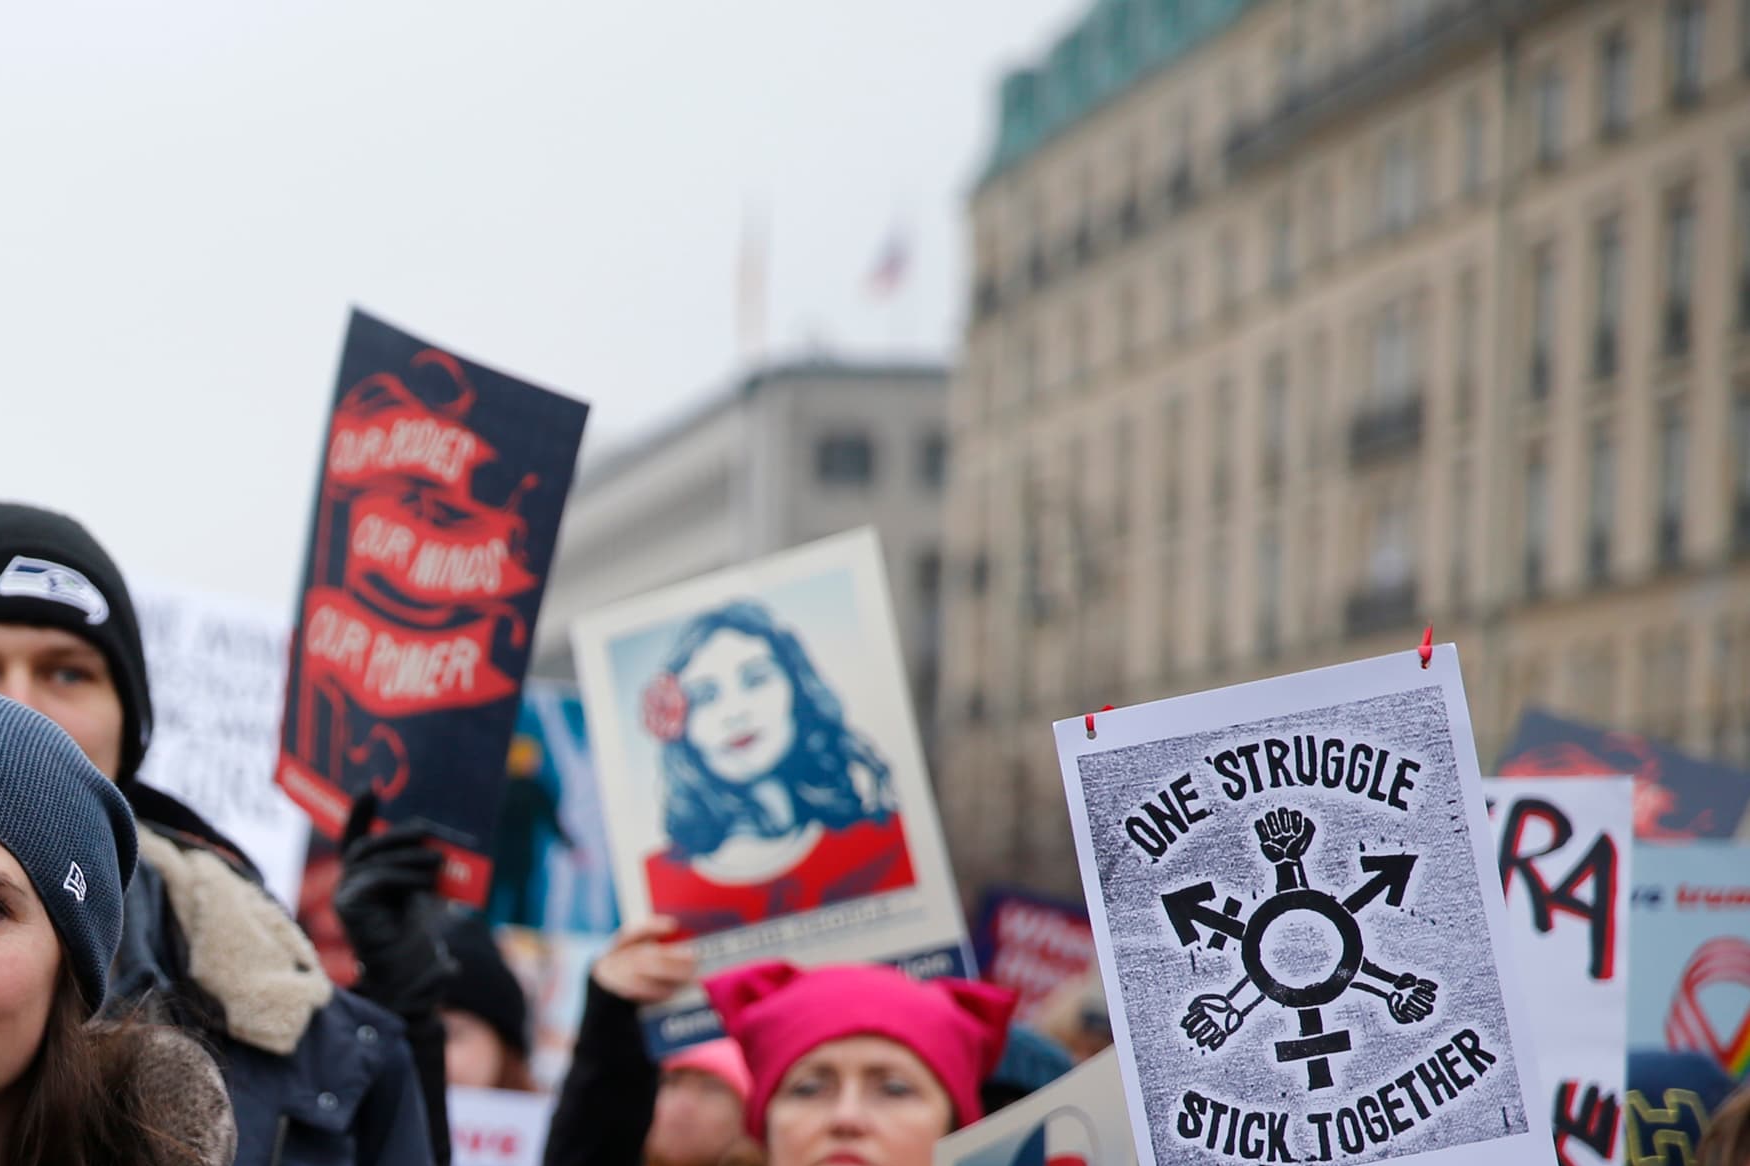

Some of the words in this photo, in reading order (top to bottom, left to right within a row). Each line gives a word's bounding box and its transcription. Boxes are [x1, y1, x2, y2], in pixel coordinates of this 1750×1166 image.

[329, 427, 385, 474] OUR
[381, 417, 476, 484] BODIES
[352, 513, 416, 568] OUR
[407, 537, 509, 594] MINDS
[306, 604, 371, 674] OUR
[363, 630, 481, 701] POWER
[1125, 772, 1212, 858] ONE
[1210, 735, 1422, 811] STRUGGLE
[1498, 796, 1618, 981] RA
[1673, 880, 1750, 910] trum
[1176, 1090, 1294, 1164] STICK
[1305, 1028, 1497, 1162] TOGETHER
